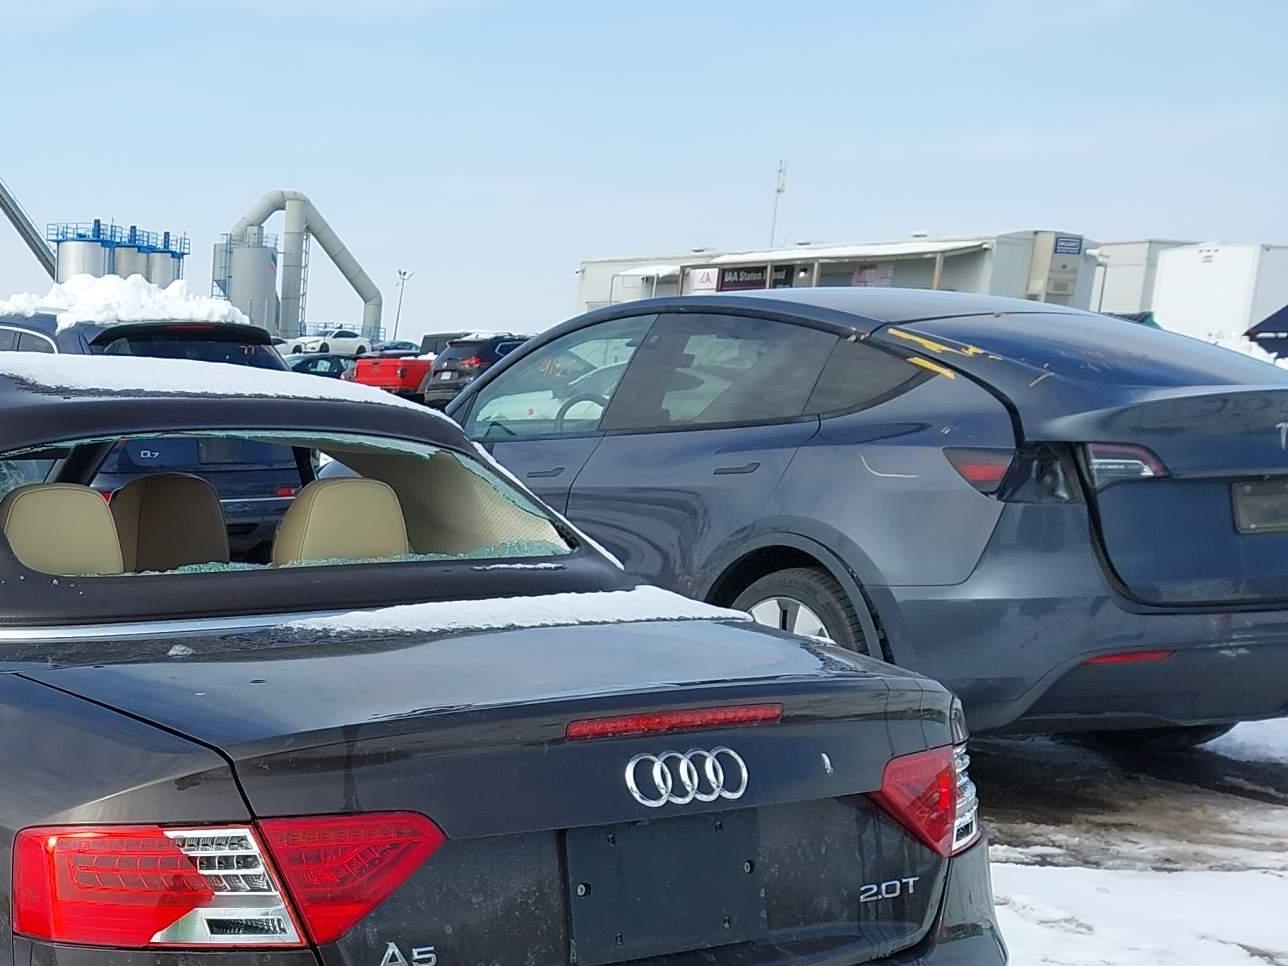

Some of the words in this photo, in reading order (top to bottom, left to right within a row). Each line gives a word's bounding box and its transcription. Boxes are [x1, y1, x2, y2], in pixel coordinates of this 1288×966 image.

[724, 271, 738, 282] IAA
[140, 450, 160, 458] Q7
[859, 876, 920, 903] 2.0T
